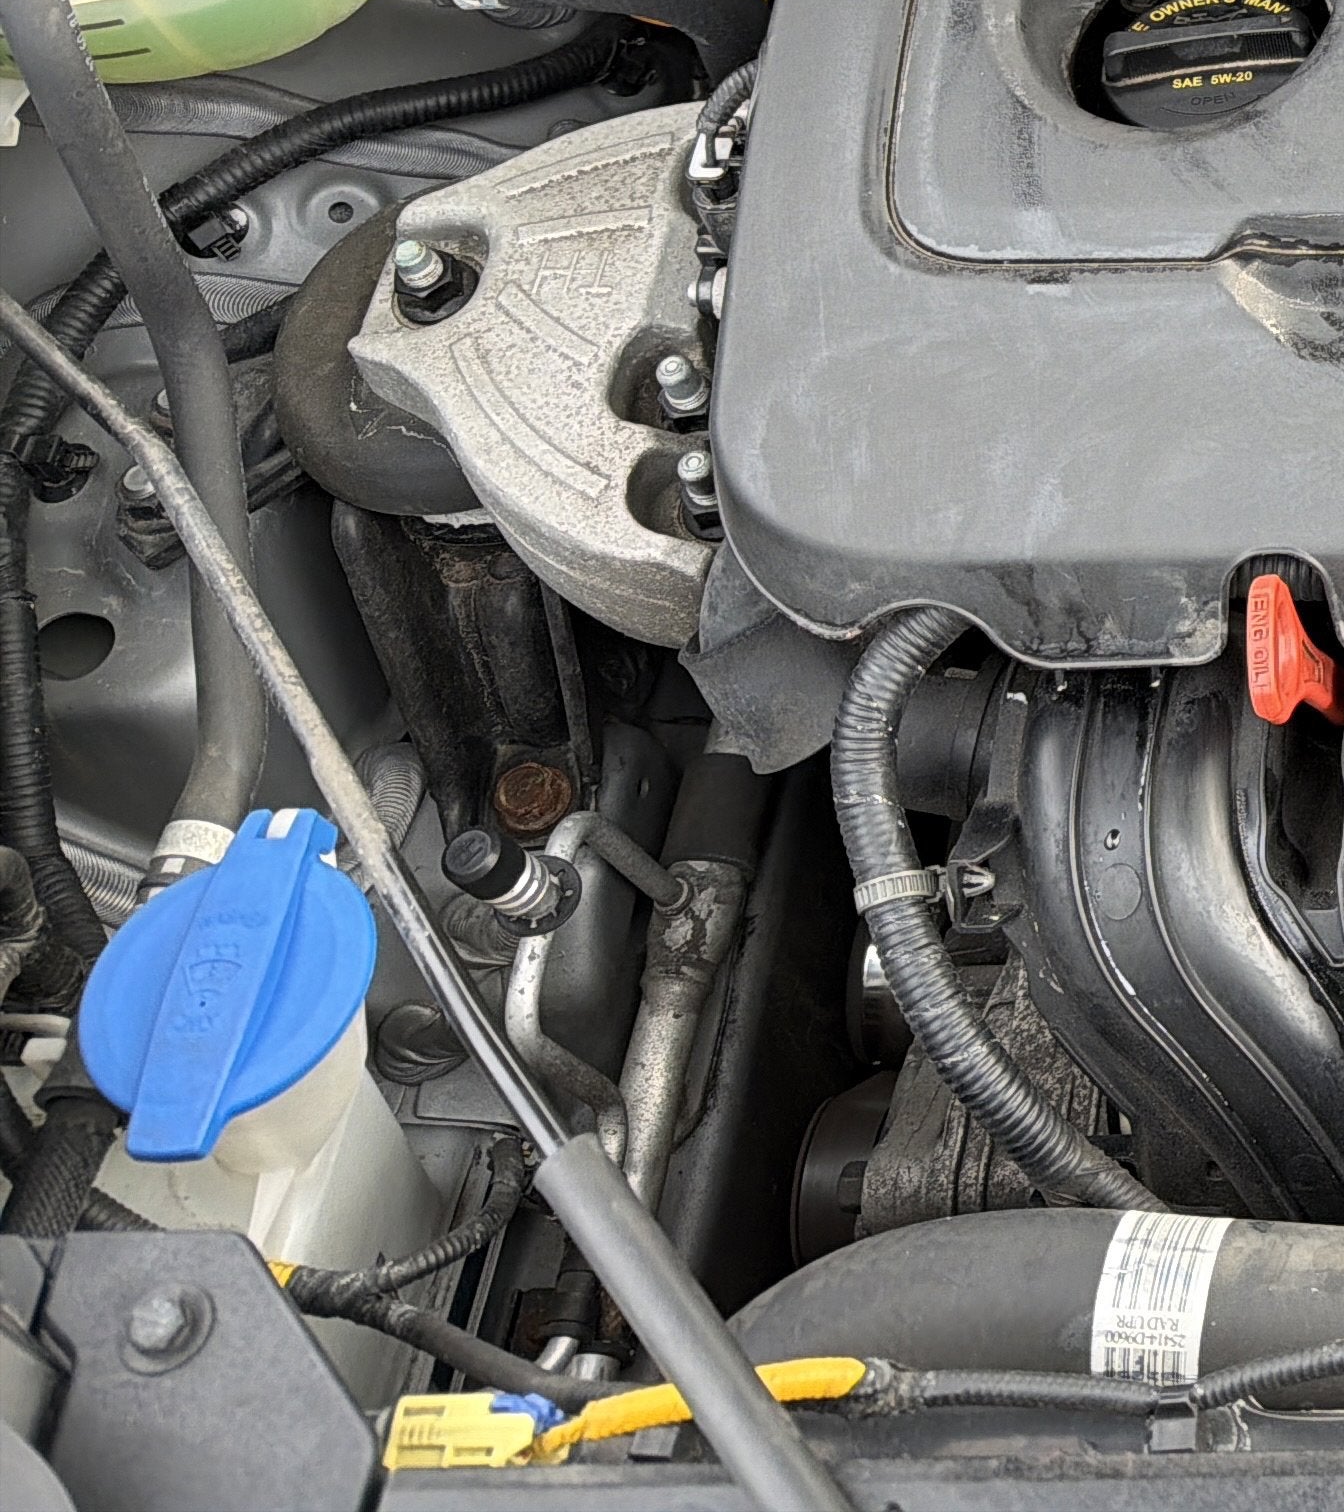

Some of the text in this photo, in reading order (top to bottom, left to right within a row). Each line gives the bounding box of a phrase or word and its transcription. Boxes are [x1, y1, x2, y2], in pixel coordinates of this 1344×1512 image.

[1171, 70, 1254, 90] SAE 5W-20
[1190, 91, 1237, 108] OPEN
[1250, 595, 1269, 685] ENG OIL
[1147, 1316, 1179, 1331] RAD
[1104, 1330, 1187, 1348] 25414-D9600
